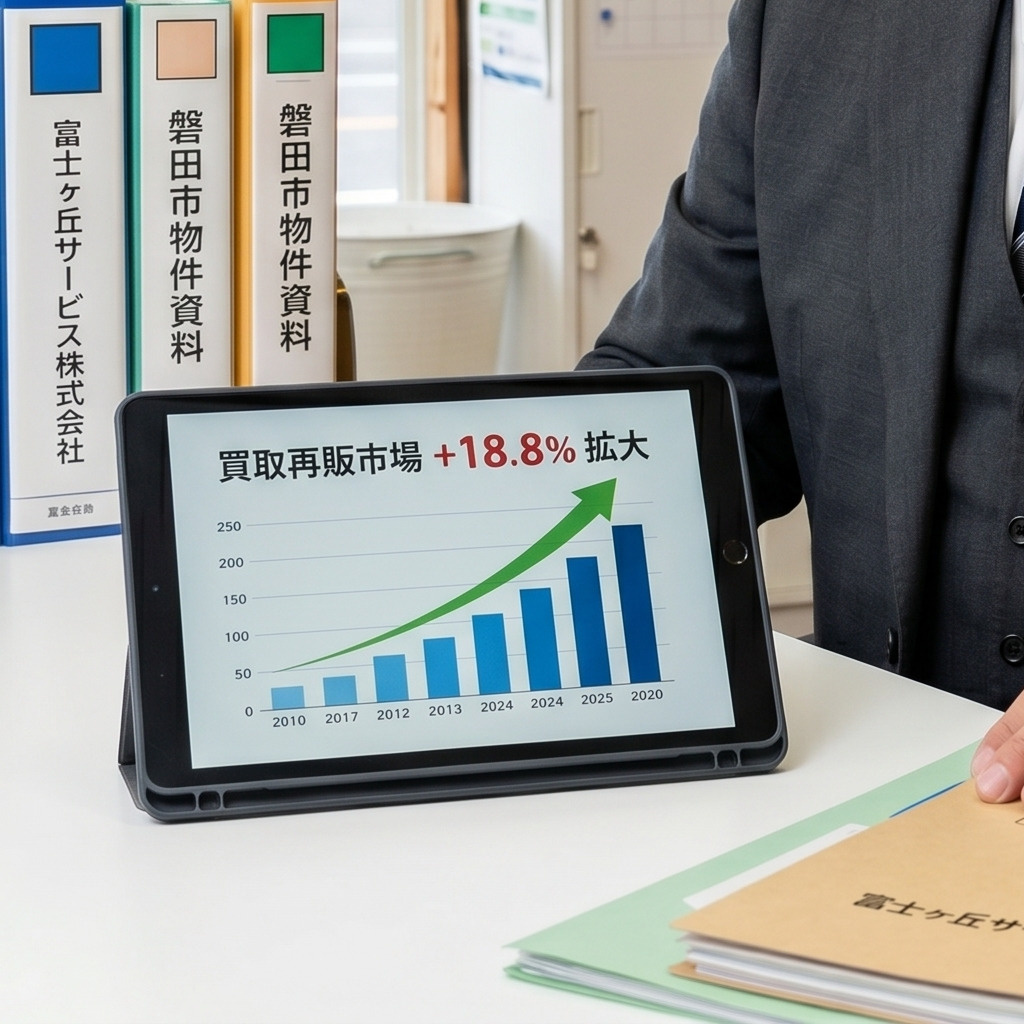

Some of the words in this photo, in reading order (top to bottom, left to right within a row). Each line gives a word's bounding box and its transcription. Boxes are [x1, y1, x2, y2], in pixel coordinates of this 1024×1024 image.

[279, 103, 312, 353] 磐田市物件資料
[169, 109, 204, 364] 磐田市物件資料
[53, 119, 85, 464] 富士ヶ丘サービス株式会社
[219, 441, 422, 483] 買取再販市場
[434, 433, 576, 468] +18.8%
[584, 429, 649, 463] 拡大
[217, 521, 241, 532] 250
[219, 557, 244, 569] 200
[224, 594, 247, 605] 150
[225, 631, 249, 642] 100
[235, 668, 251, 680] 50
[245, 706, 253, 717] 0
[273, 715, 306, 727] 2010
[325, 711, 358, 724] 2017
[377, 708, 410, 720] 2012
[429, 704, 462, 716] 2013
[481, 700, 513, 712] 2024
[531, 696, 564, 708] 2024
[581, 693, 613, 705] 2025
[631, 689, 663, 701] 2020
